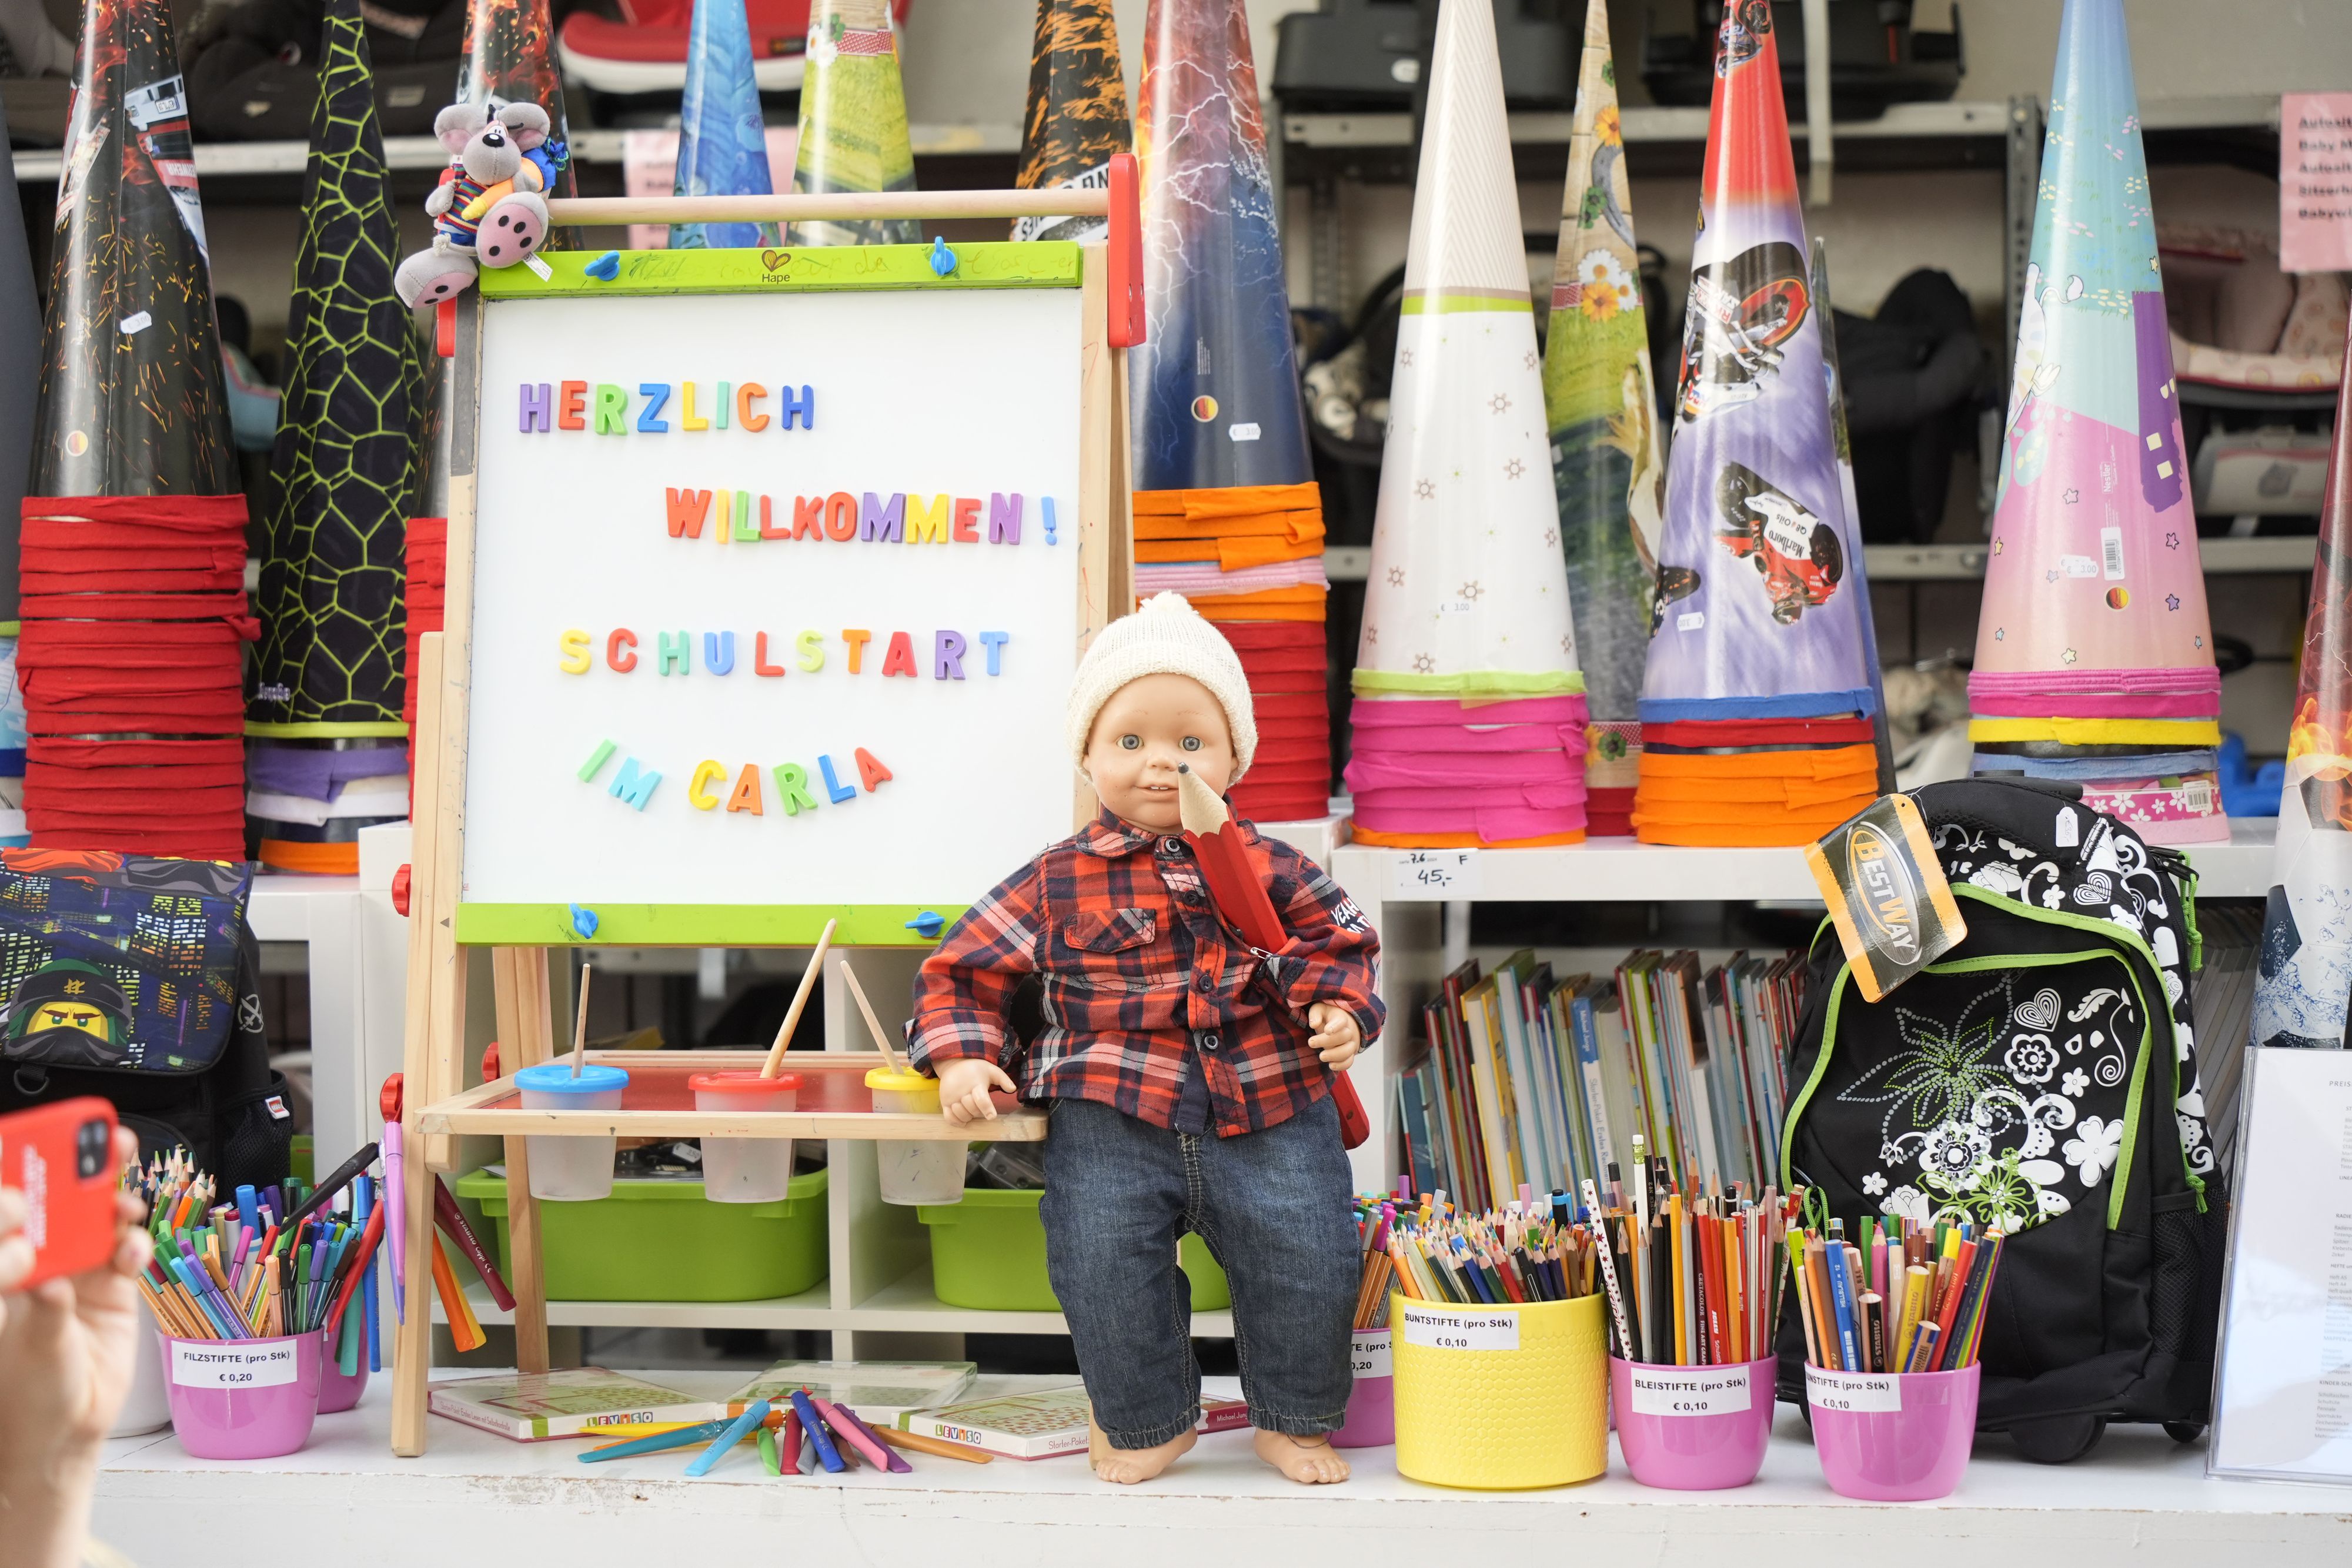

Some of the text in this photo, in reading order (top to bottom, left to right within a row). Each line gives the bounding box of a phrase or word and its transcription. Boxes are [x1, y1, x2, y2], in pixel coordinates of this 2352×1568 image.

[761, 273, 790, 285] Hape
[519, 380, 815, 436] HERZLICH
[2103, 463, 2112, 493] Nestler
[1769, 530, 1805, 559] Marlboro
[2080, 564, 2097, 574] 3.00
[1454, 603, 1469, 611] 3.00
[559, 627, 1009, 680] SCHULSTART
[577, 738, 893, 817] IM CARLA
[1410, 853, 1425, 864] 7.6
[1459, 855, 1468, 865] F
[1331, 897, 1360, 927] YEAH
[459, 1219, 477, 1245] STABILO
[475, 1246, 486, 1262] cappi
[1836, 1281, 1846, 1308] HELLBLAU
[1908, 1290, 1919, 1327] STABILO
[1405, 1312, 1512, 1329] BUNTSTIFTE (pro Stk)
[1366, 1342, 1386, 1353] (pro
[1436, 1338, 1467, 1348] € 0,10
[184, 1350, 290, 1365] FILZSTIFTE (pro Stk)
[229, 1373, 252, 1382] 0,20
[1635, 1378, 1746, 1392] BLEISTIFTE (pro Stk)
[1842, 1381, 1862, 1391] (pro
[1866, 1381, 1889, 1392] Stk)
[1683, 1402, 1708, 1412] 0,10
[1823, 1398, 1849, 1409] € 0,10
[1217, 1412, 1236, 1422] Michael
